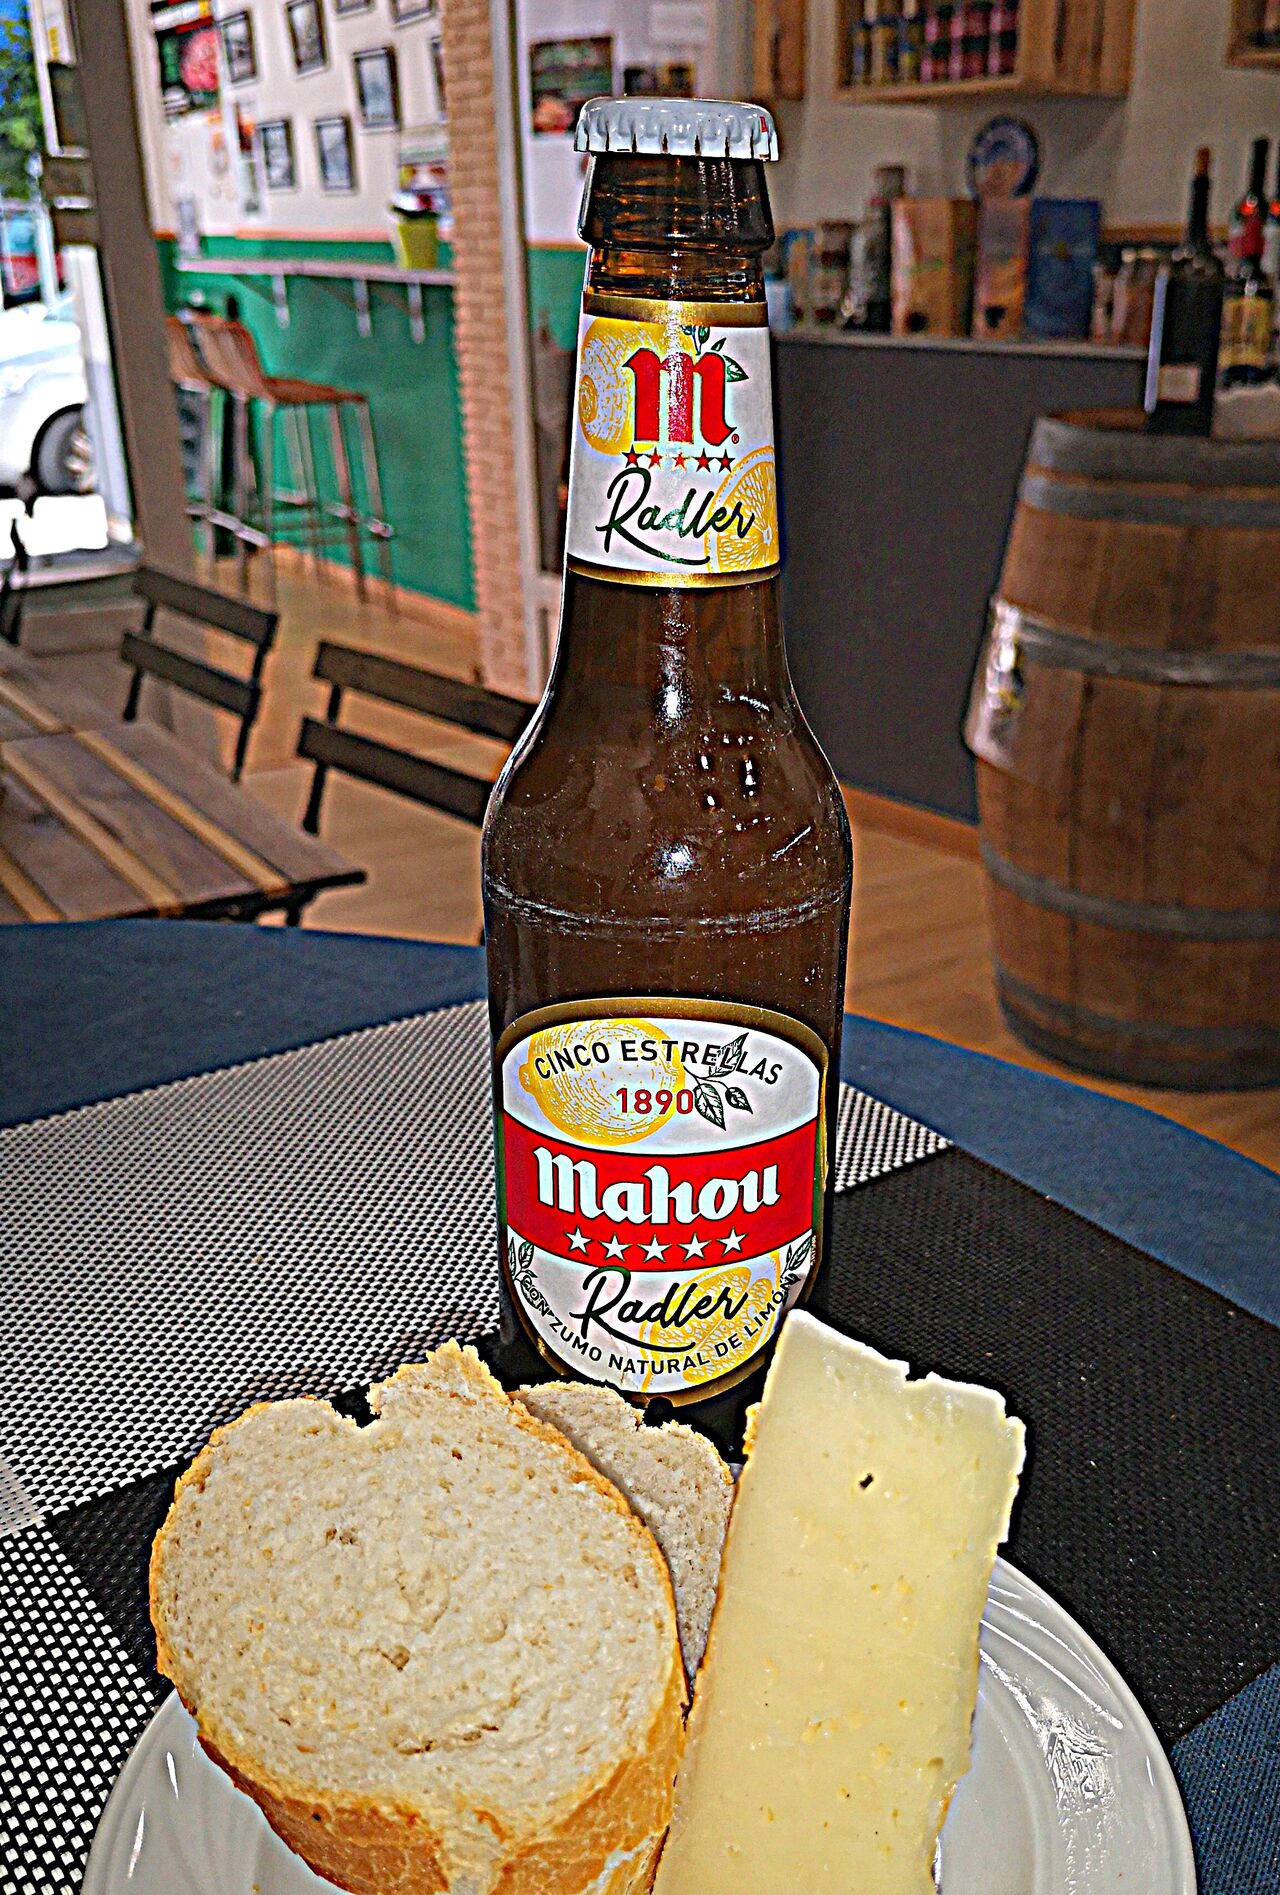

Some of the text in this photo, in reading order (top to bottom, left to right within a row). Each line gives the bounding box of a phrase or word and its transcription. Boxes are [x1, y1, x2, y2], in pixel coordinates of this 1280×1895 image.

[595, 467, 755, 565] Radler
[534, 1039, 783, 1086] CINCO ESTRELLAS
[616, 1086, 694, 1115] 1890
[521, 1274, 794, 1375] CON ZUMO NATURAL DE LIMÓN
[569, 1265, 749, 1353] Radler
